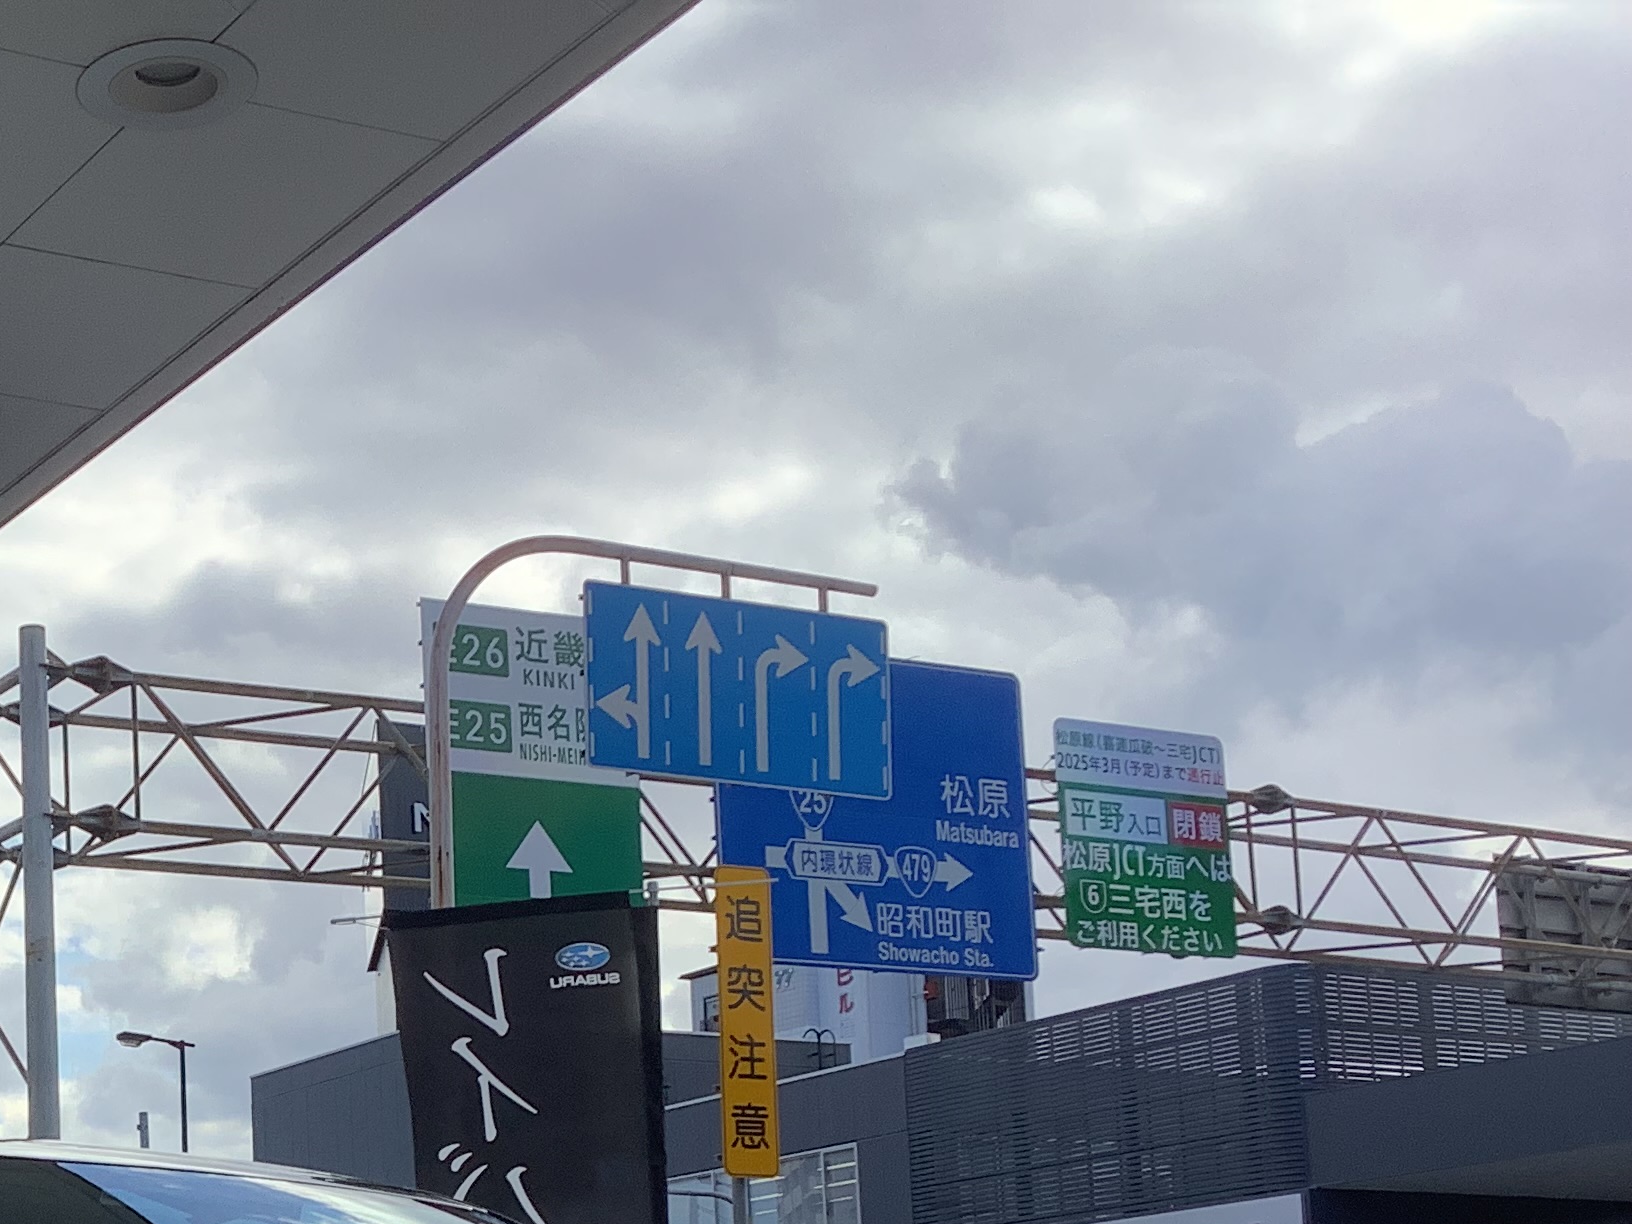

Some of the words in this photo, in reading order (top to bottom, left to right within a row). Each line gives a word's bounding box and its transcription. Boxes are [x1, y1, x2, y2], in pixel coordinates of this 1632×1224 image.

[523, 669, 575, 690] KINKI
[940, 774, 1011, 819] 松原
[935, 819, 1019, 849] Matsubara
[1071, 797, 1162, 837] 平野入口
[1172, 808, 1223, 842] 閉鎖
[801, 850, 874, 877] 内環状線
[902, 854, 931, 883] 479
[1063, 840, 1231, 883] 松原JCT方面へは
[1087, 884, 1100, 906] 6
[1108, 883, 1212, 921] 三宅西を
[876, 902, 994, 945] 昭和町駅
[1077, 919, 1223, 952] ご利用ください
[878, 941, 959, 965] Showacho
[964, 947, 995, 968] Sta.
[725, 895, 770, 1150] 追突注意
